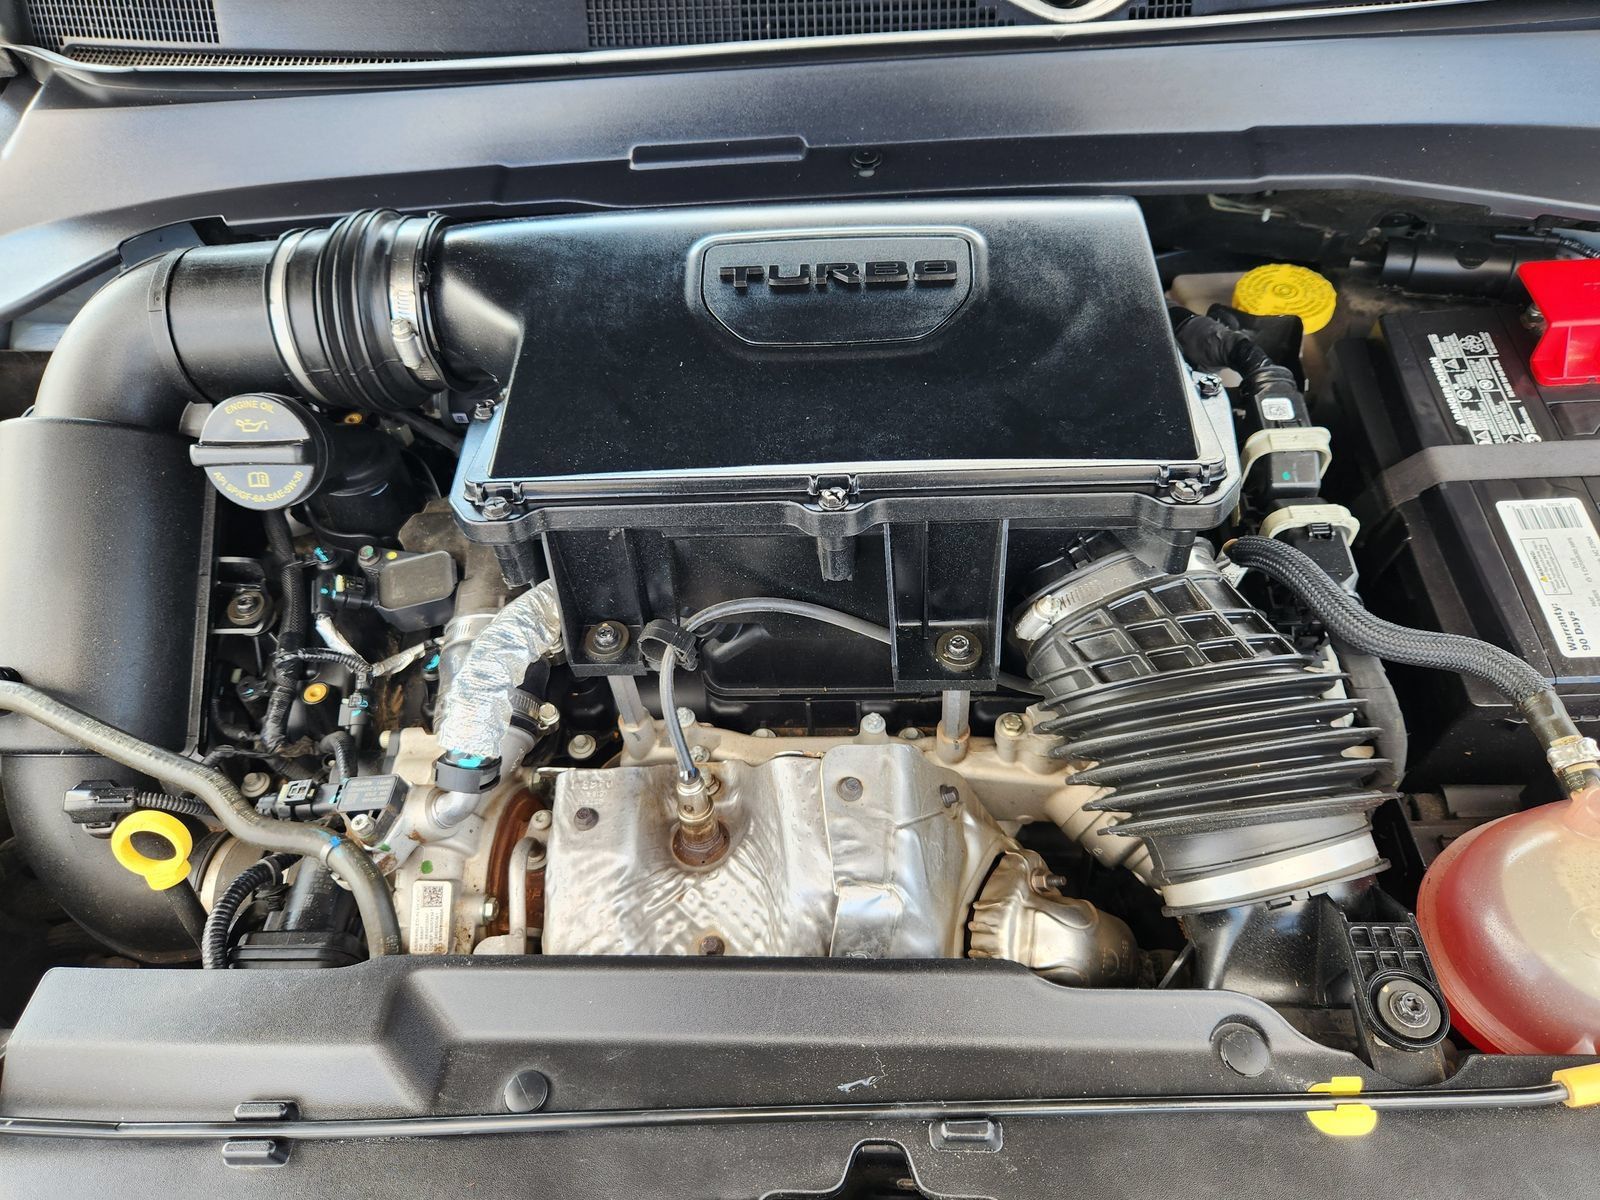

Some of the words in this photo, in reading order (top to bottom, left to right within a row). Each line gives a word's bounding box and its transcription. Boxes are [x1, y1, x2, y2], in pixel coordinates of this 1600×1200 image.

[720, 259, 957, 288] TURBO
[224, 400, 258, 415] ENGINE
[259, 402, 275, 413] OIL
[213, 471, 226, 487] API
[1551, 603, 1577, 652] Warranty:
[1568, 611, 1585, 635] Days
[1579, 637, 1591, 652] 90
